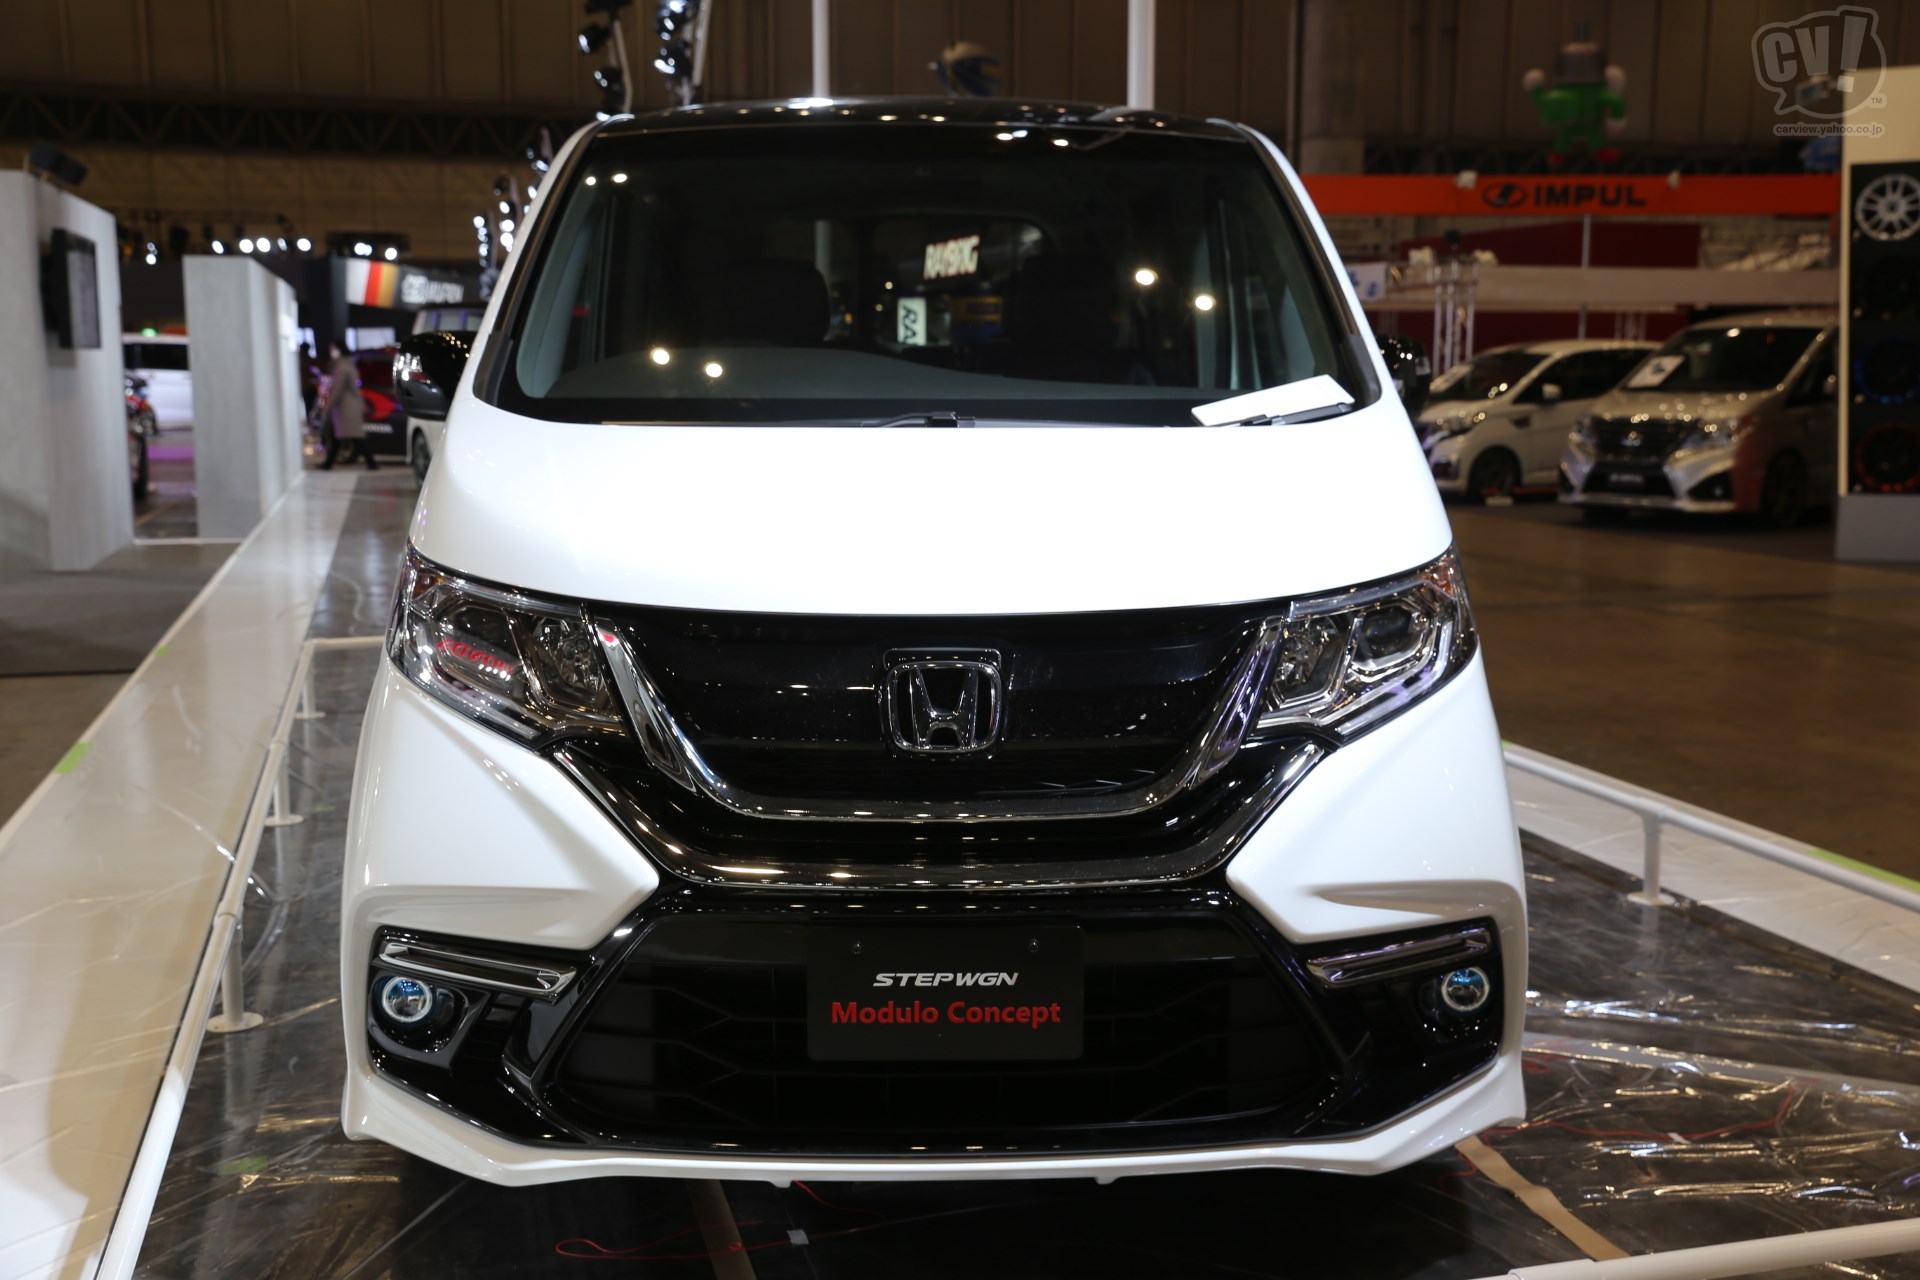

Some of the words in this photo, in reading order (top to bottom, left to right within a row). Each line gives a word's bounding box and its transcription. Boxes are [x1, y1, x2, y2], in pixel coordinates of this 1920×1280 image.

[1534, 184, 1648, 208] IMPUL
[872, 972, 1020, 987] STEPWGN
[831, 1001, 939, 1024] Modulo
[947, 1002, 1061, 1029] Concept
